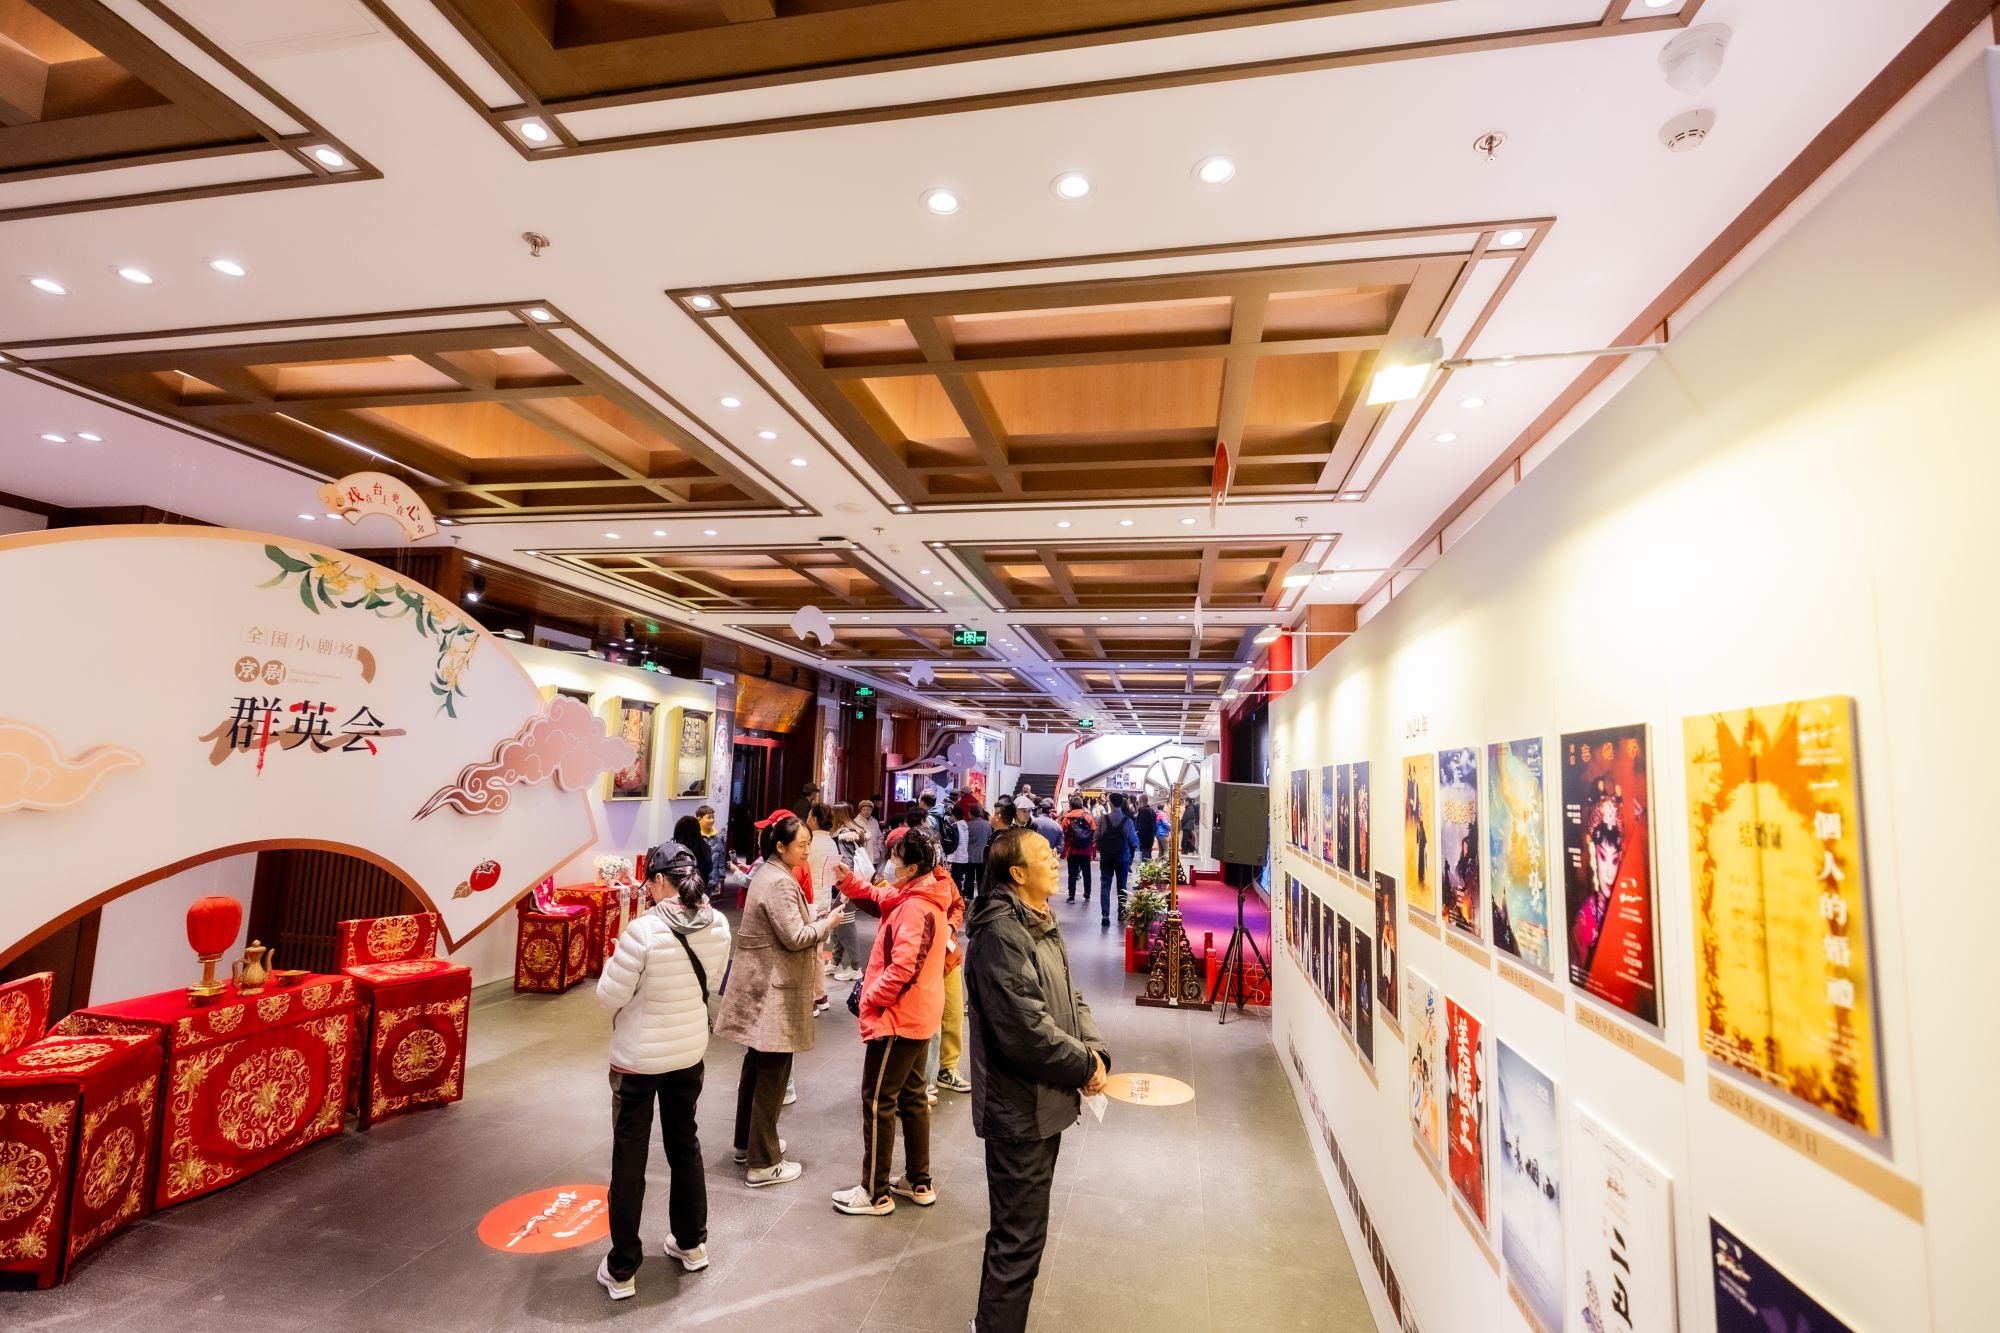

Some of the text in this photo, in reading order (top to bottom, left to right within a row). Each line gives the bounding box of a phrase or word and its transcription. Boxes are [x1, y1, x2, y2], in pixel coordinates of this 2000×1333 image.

[247, 626, 354, 659] 全国小剧场
[236, 657, 286, 685] 京剧
[225, 695, 386, 777] 群英会
